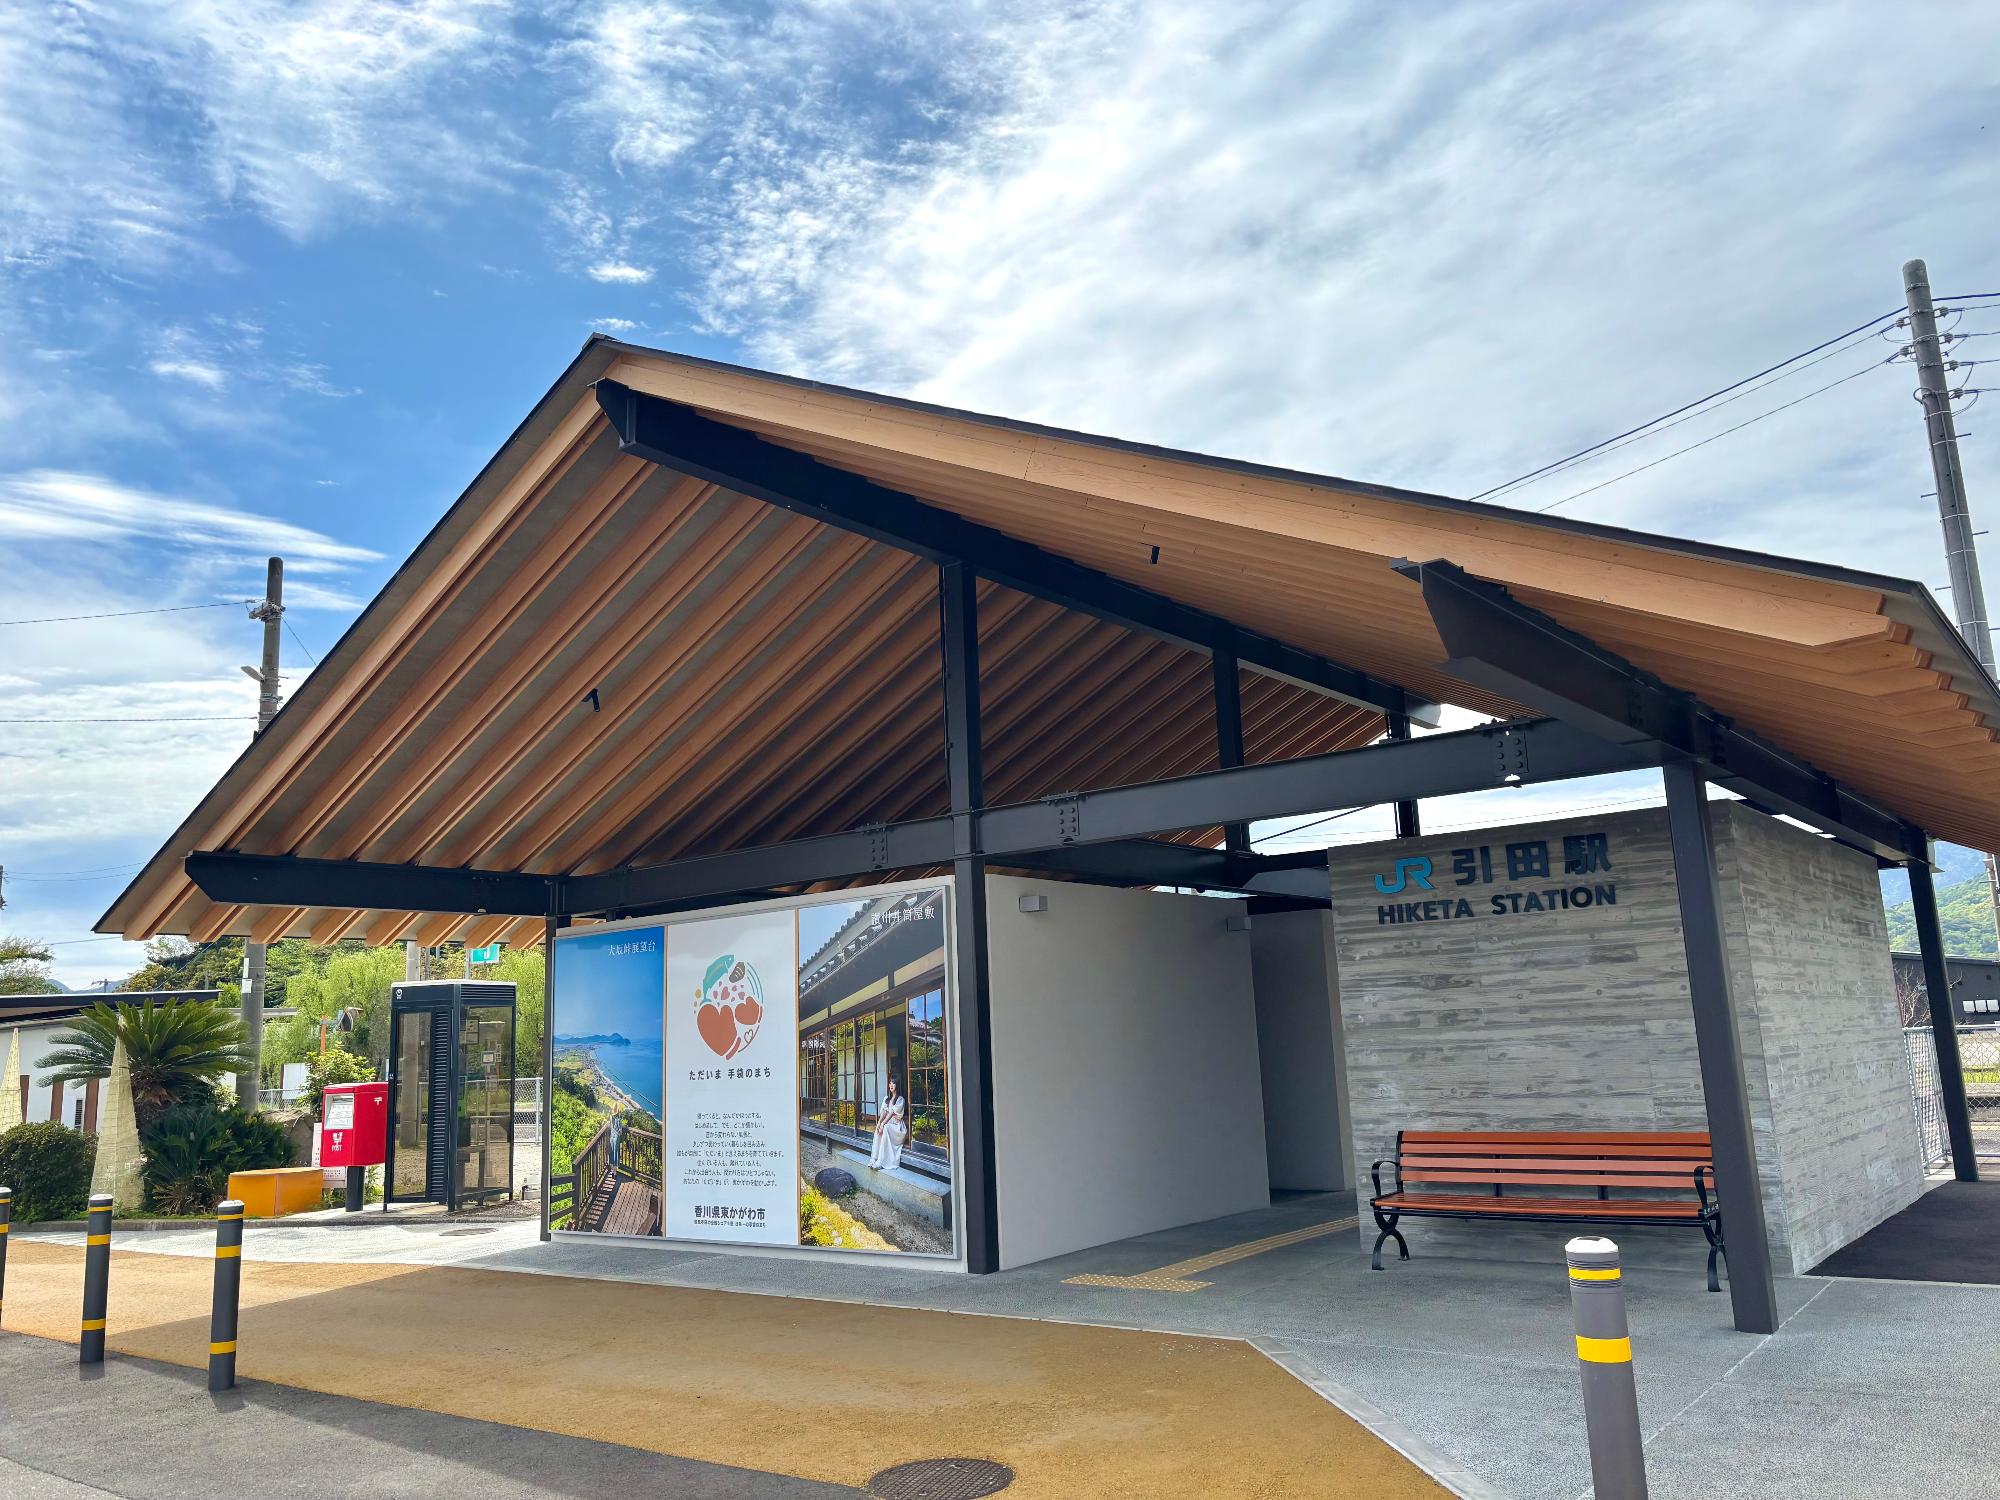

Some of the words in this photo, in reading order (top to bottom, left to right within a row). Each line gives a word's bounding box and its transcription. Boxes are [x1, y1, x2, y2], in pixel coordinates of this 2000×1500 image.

[1374, 856, 1436, 895] JR
[1451, 832, 1613, 887] 引田駅
[1377, 898, 1475, 925] HIKETA
[1490, 883, 1617, 916] STATION
[607, 939, 656, 956] 大坂峠展望台
[689, 1069, 722, 1080] ただいま
[727, 1066, 771, 1079] 手袋のまち
[694, 1205, 766, 1220] 香川県東かがわ市
